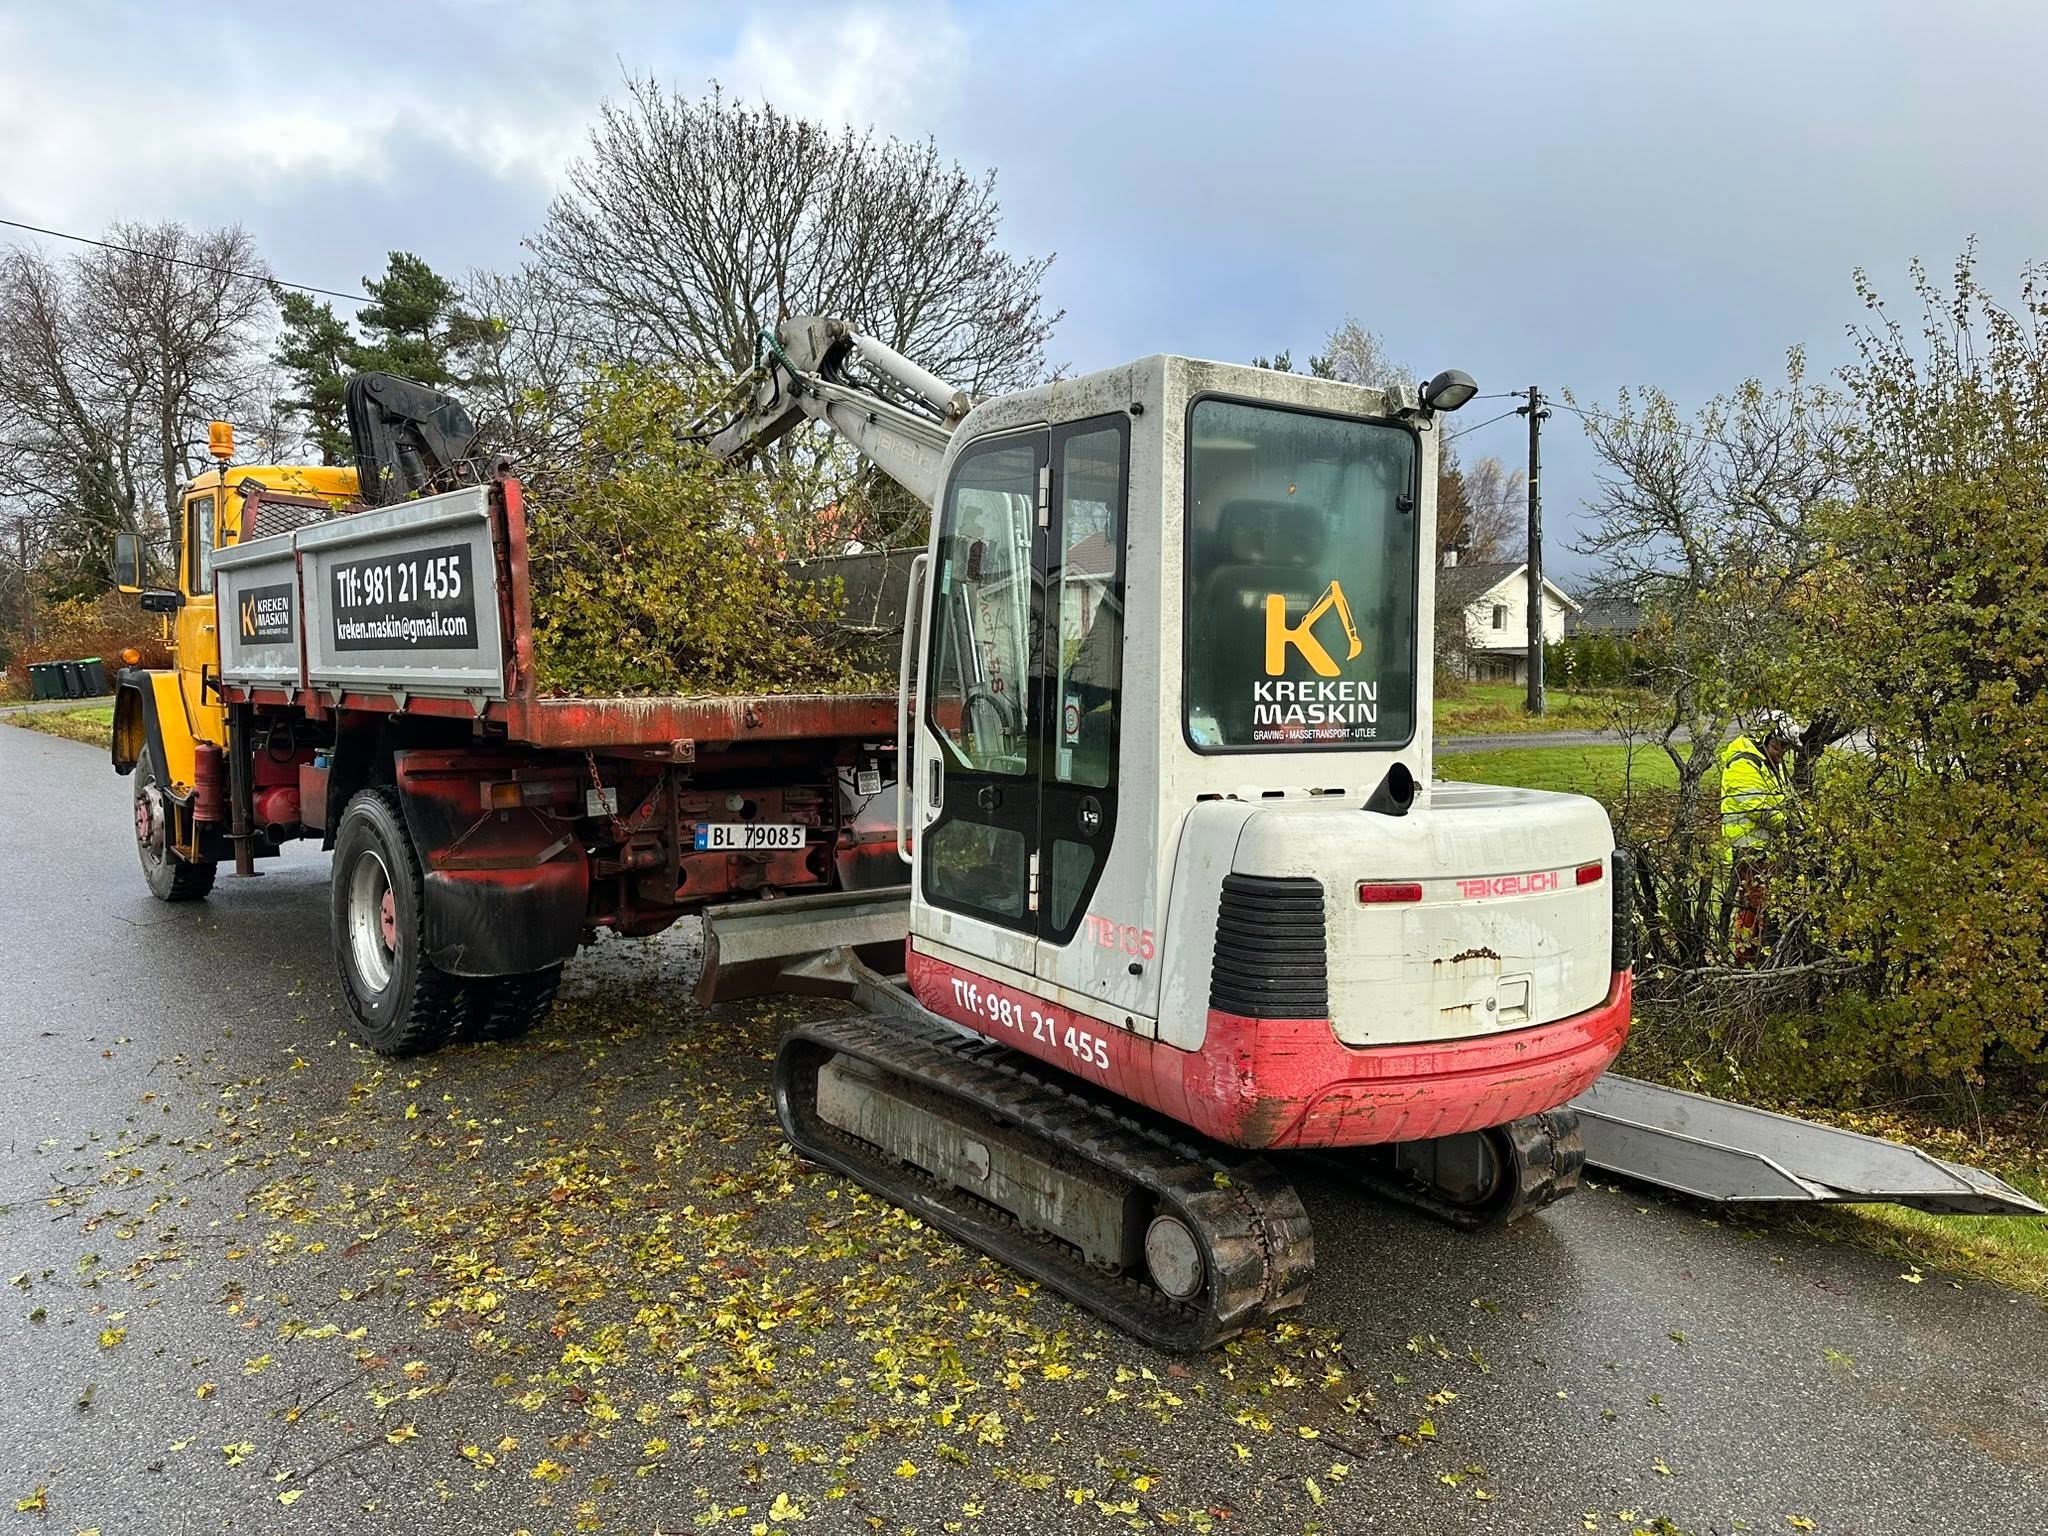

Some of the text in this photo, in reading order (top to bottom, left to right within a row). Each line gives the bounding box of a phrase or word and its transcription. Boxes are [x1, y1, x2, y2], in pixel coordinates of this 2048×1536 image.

[336, 555, 461, 608] Tlf: 981 21 455
[257, 597, 289, 613] KREKEN
[257, 611, 289, 627] MASKIN
[336, 611, 468, 644] kreken.maskin@gmail.com
[1253, 680, 1377, 702] KREKEN
[1253, 703, 1377, 725] MASKIN
[1253, 727, 1377, 741] GRAVING MASSETRANSPORT UTLEIE
[713, 827, 801, 846] BL 79085
[1456, 871, 1558, 900] TAKEUCHI
[951, 977, 1110, 1070] Tlf: 981 21 455
